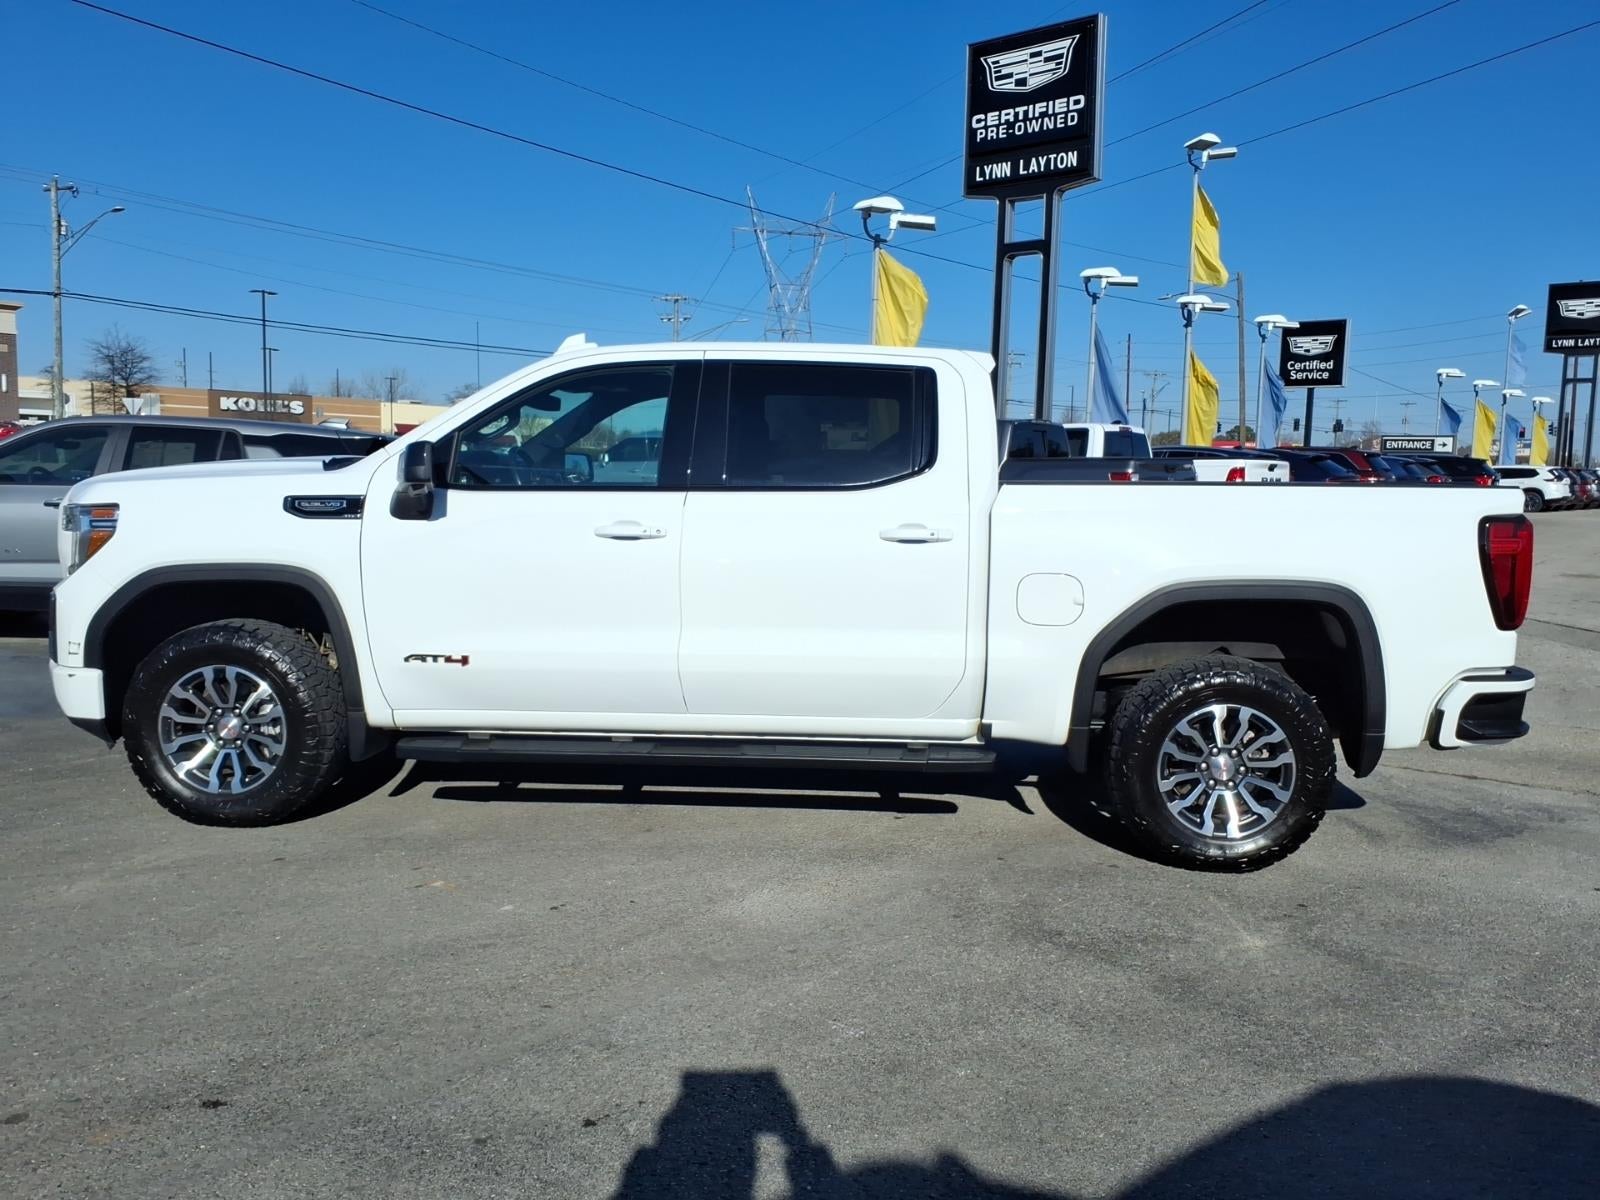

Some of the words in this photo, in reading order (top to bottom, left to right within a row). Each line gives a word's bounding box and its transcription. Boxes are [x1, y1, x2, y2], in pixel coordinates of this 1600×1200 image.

[972, 95, 1085, 129] CERTIFIED
[977, 112, 1078, 142] PRE-OWNED
[976, 161, 1011, 182] LYNN
[1019, 151, 1078, 175] LAYTON
[1552, 339, 1575, 347] LYNN
[1287, 360, 1334, 370] Certified
[1290, 370, 1329, 380] Service
[1386, 440, 1433, 449] ENTRANCE
[404, 654, 469, 667] AT4
